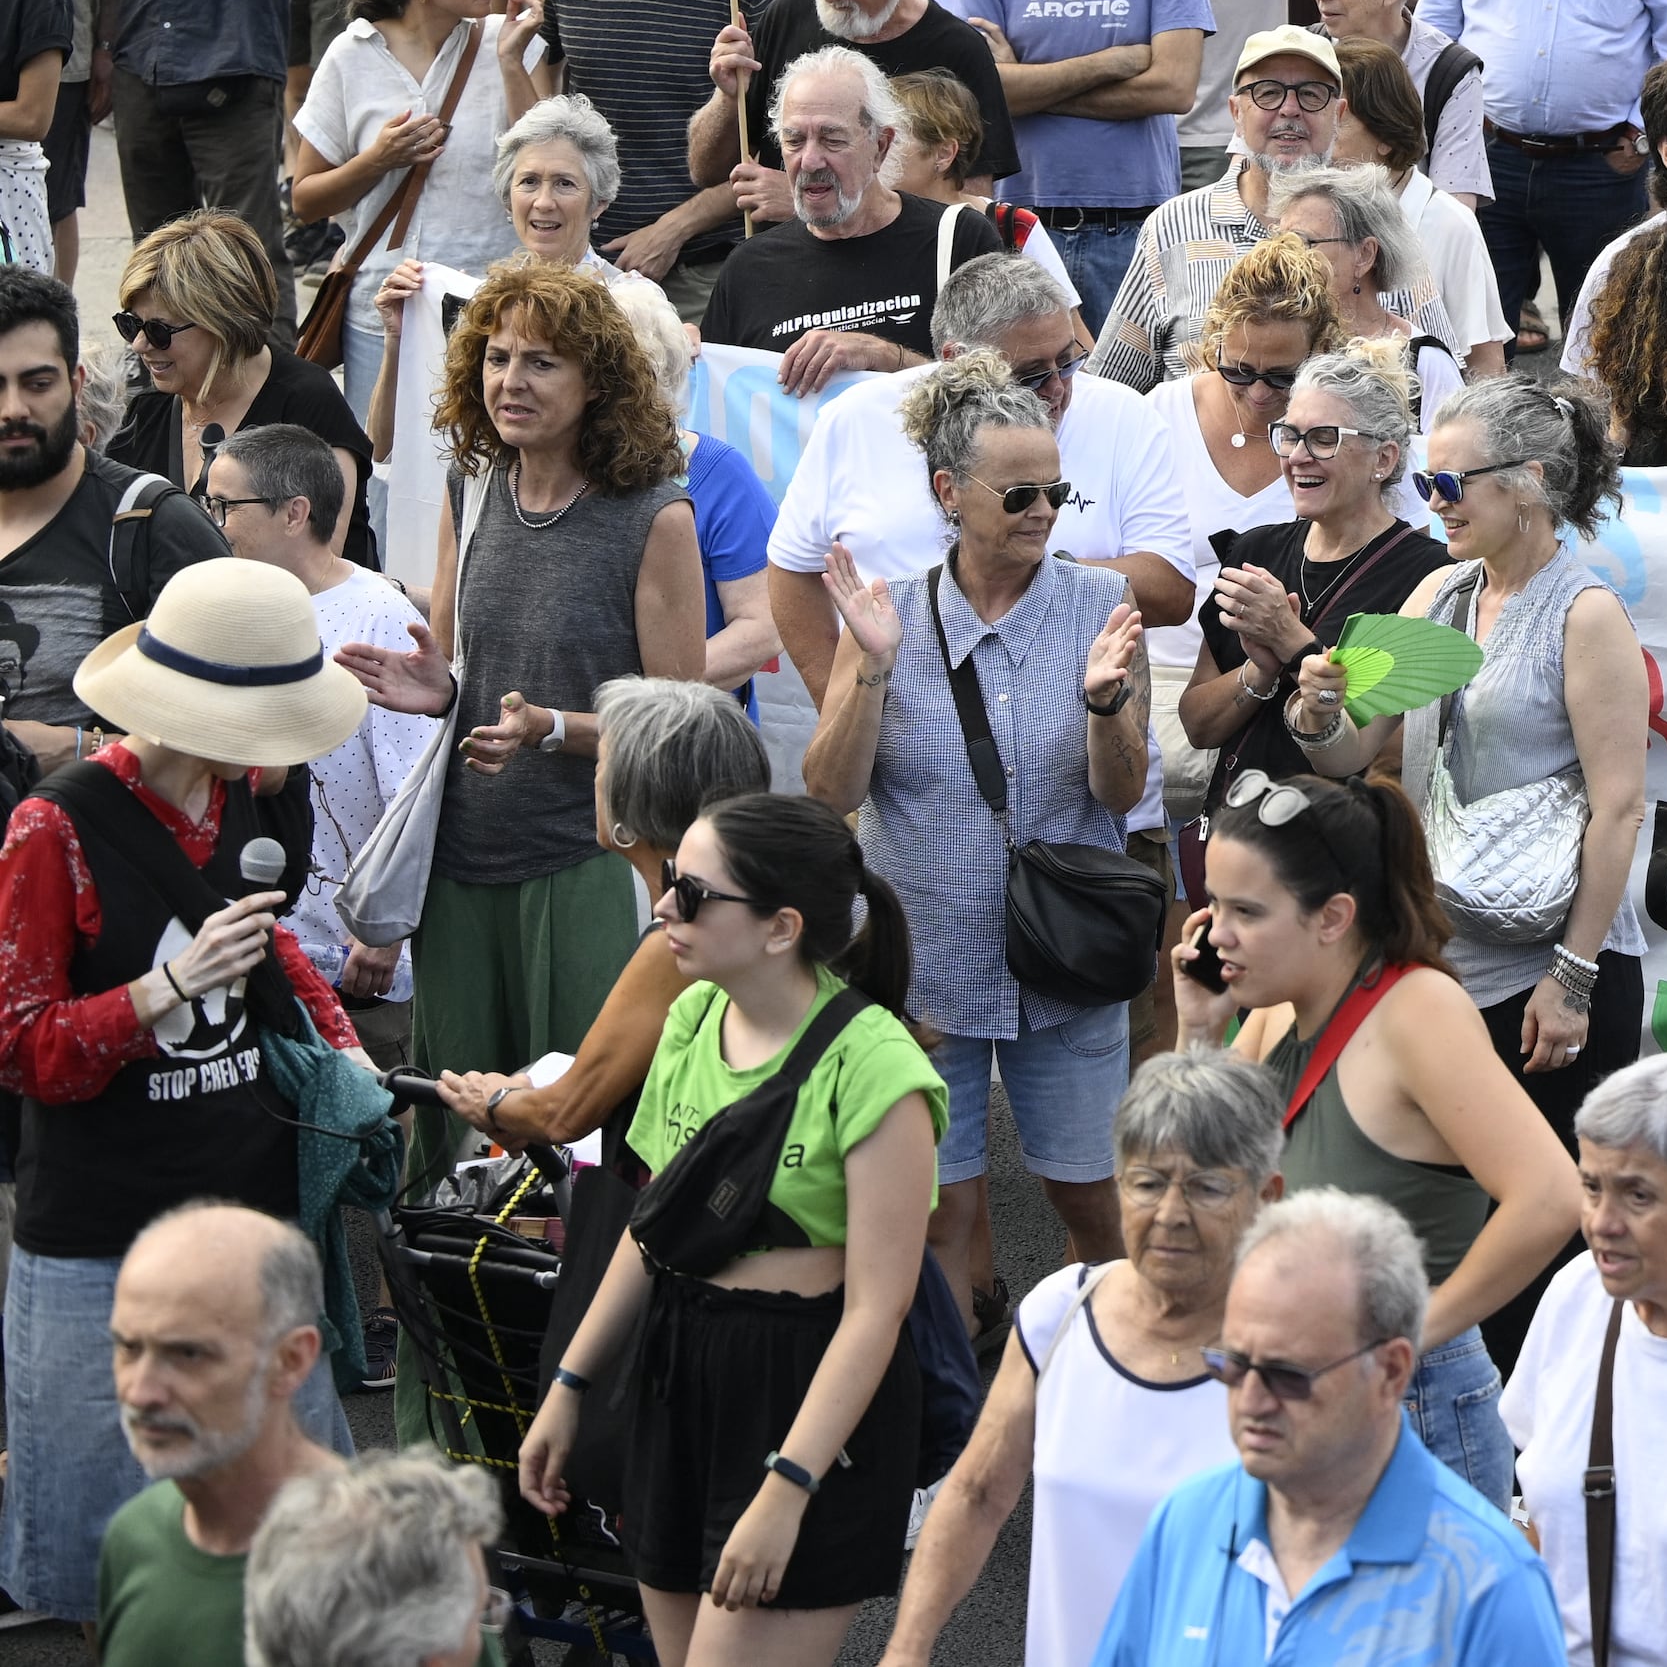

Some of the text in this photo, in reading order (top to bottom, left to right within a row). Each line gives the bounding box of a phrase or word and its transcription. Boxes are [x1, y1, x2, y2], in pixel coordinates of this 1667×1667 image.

[1022, 0, 1130, 18] ARCTIC
[771, 293, 922, 338] #ILPRegularizacion
[861, 316, 886, 327] social
[148, 1046, 260, 1101] STOP CREUERS
